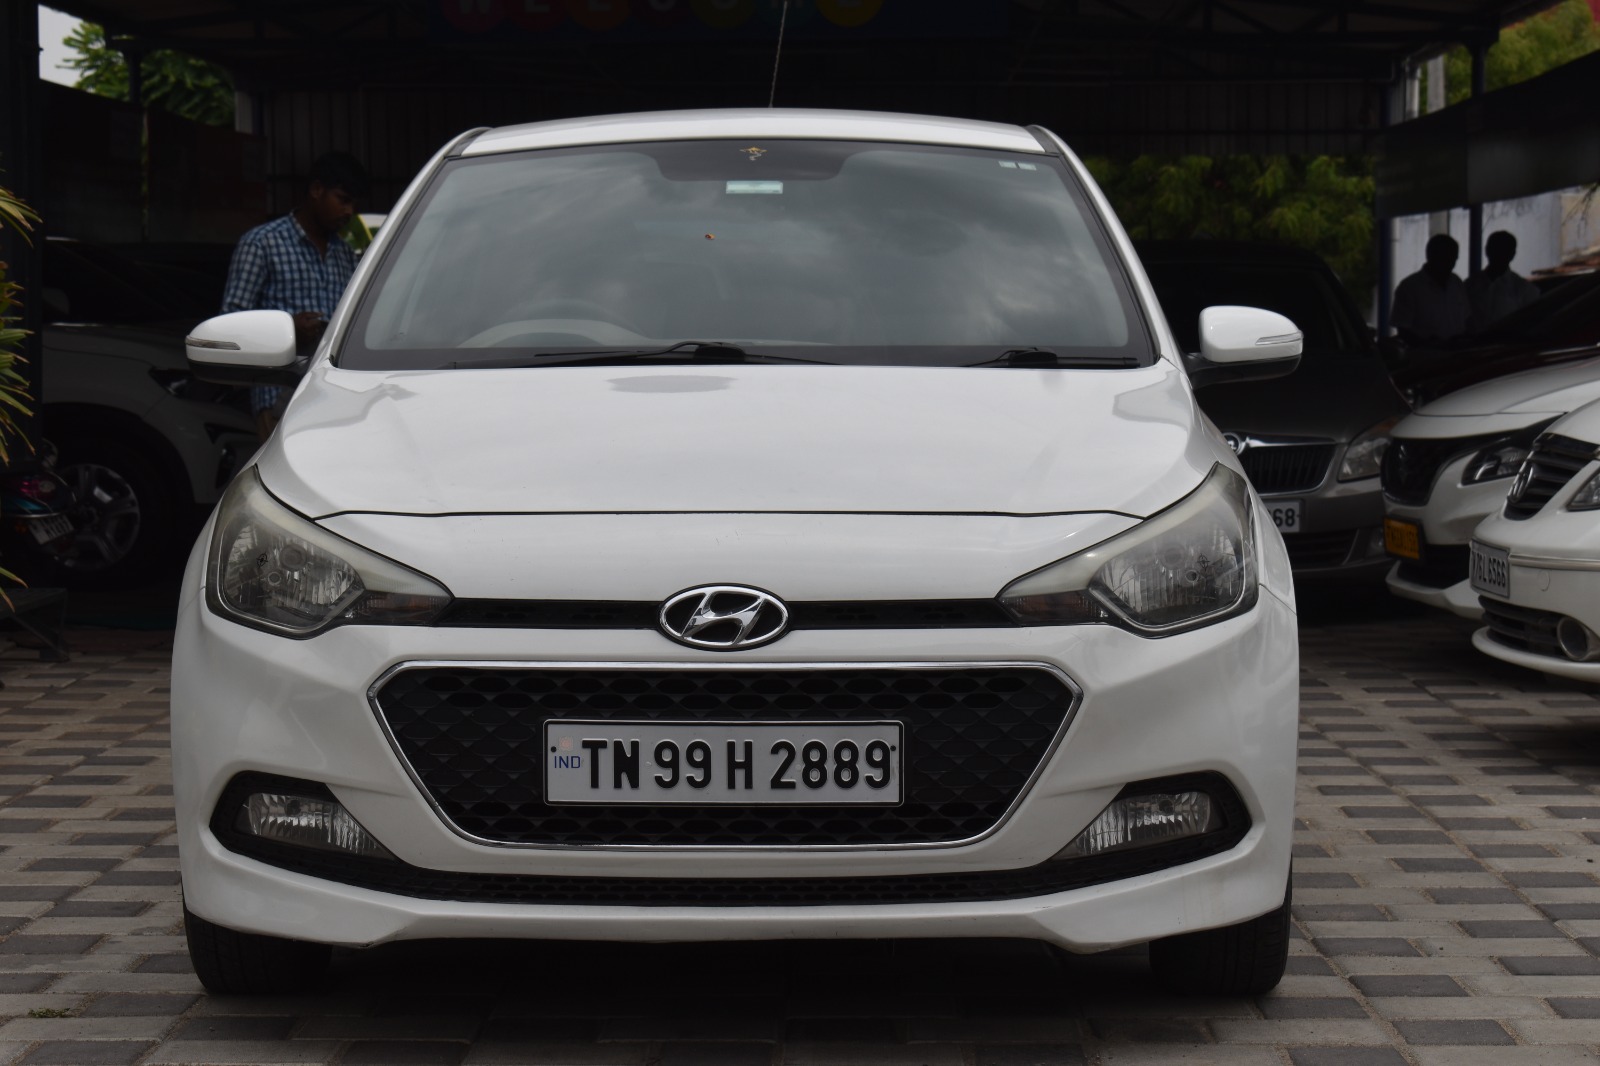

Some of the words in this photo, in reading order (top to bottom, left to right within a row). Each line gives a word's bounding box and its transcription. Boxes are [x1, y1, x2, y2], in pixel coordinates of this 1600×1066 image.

[1267, 507, 1296, 528] 68
[554, 756, 581, 769] IND
[581, 739, 640, 789] TN
[653, 739, 712, 789] 99
[727, 740, 753, 790] H
[770, 739, 891, 790] 2889
